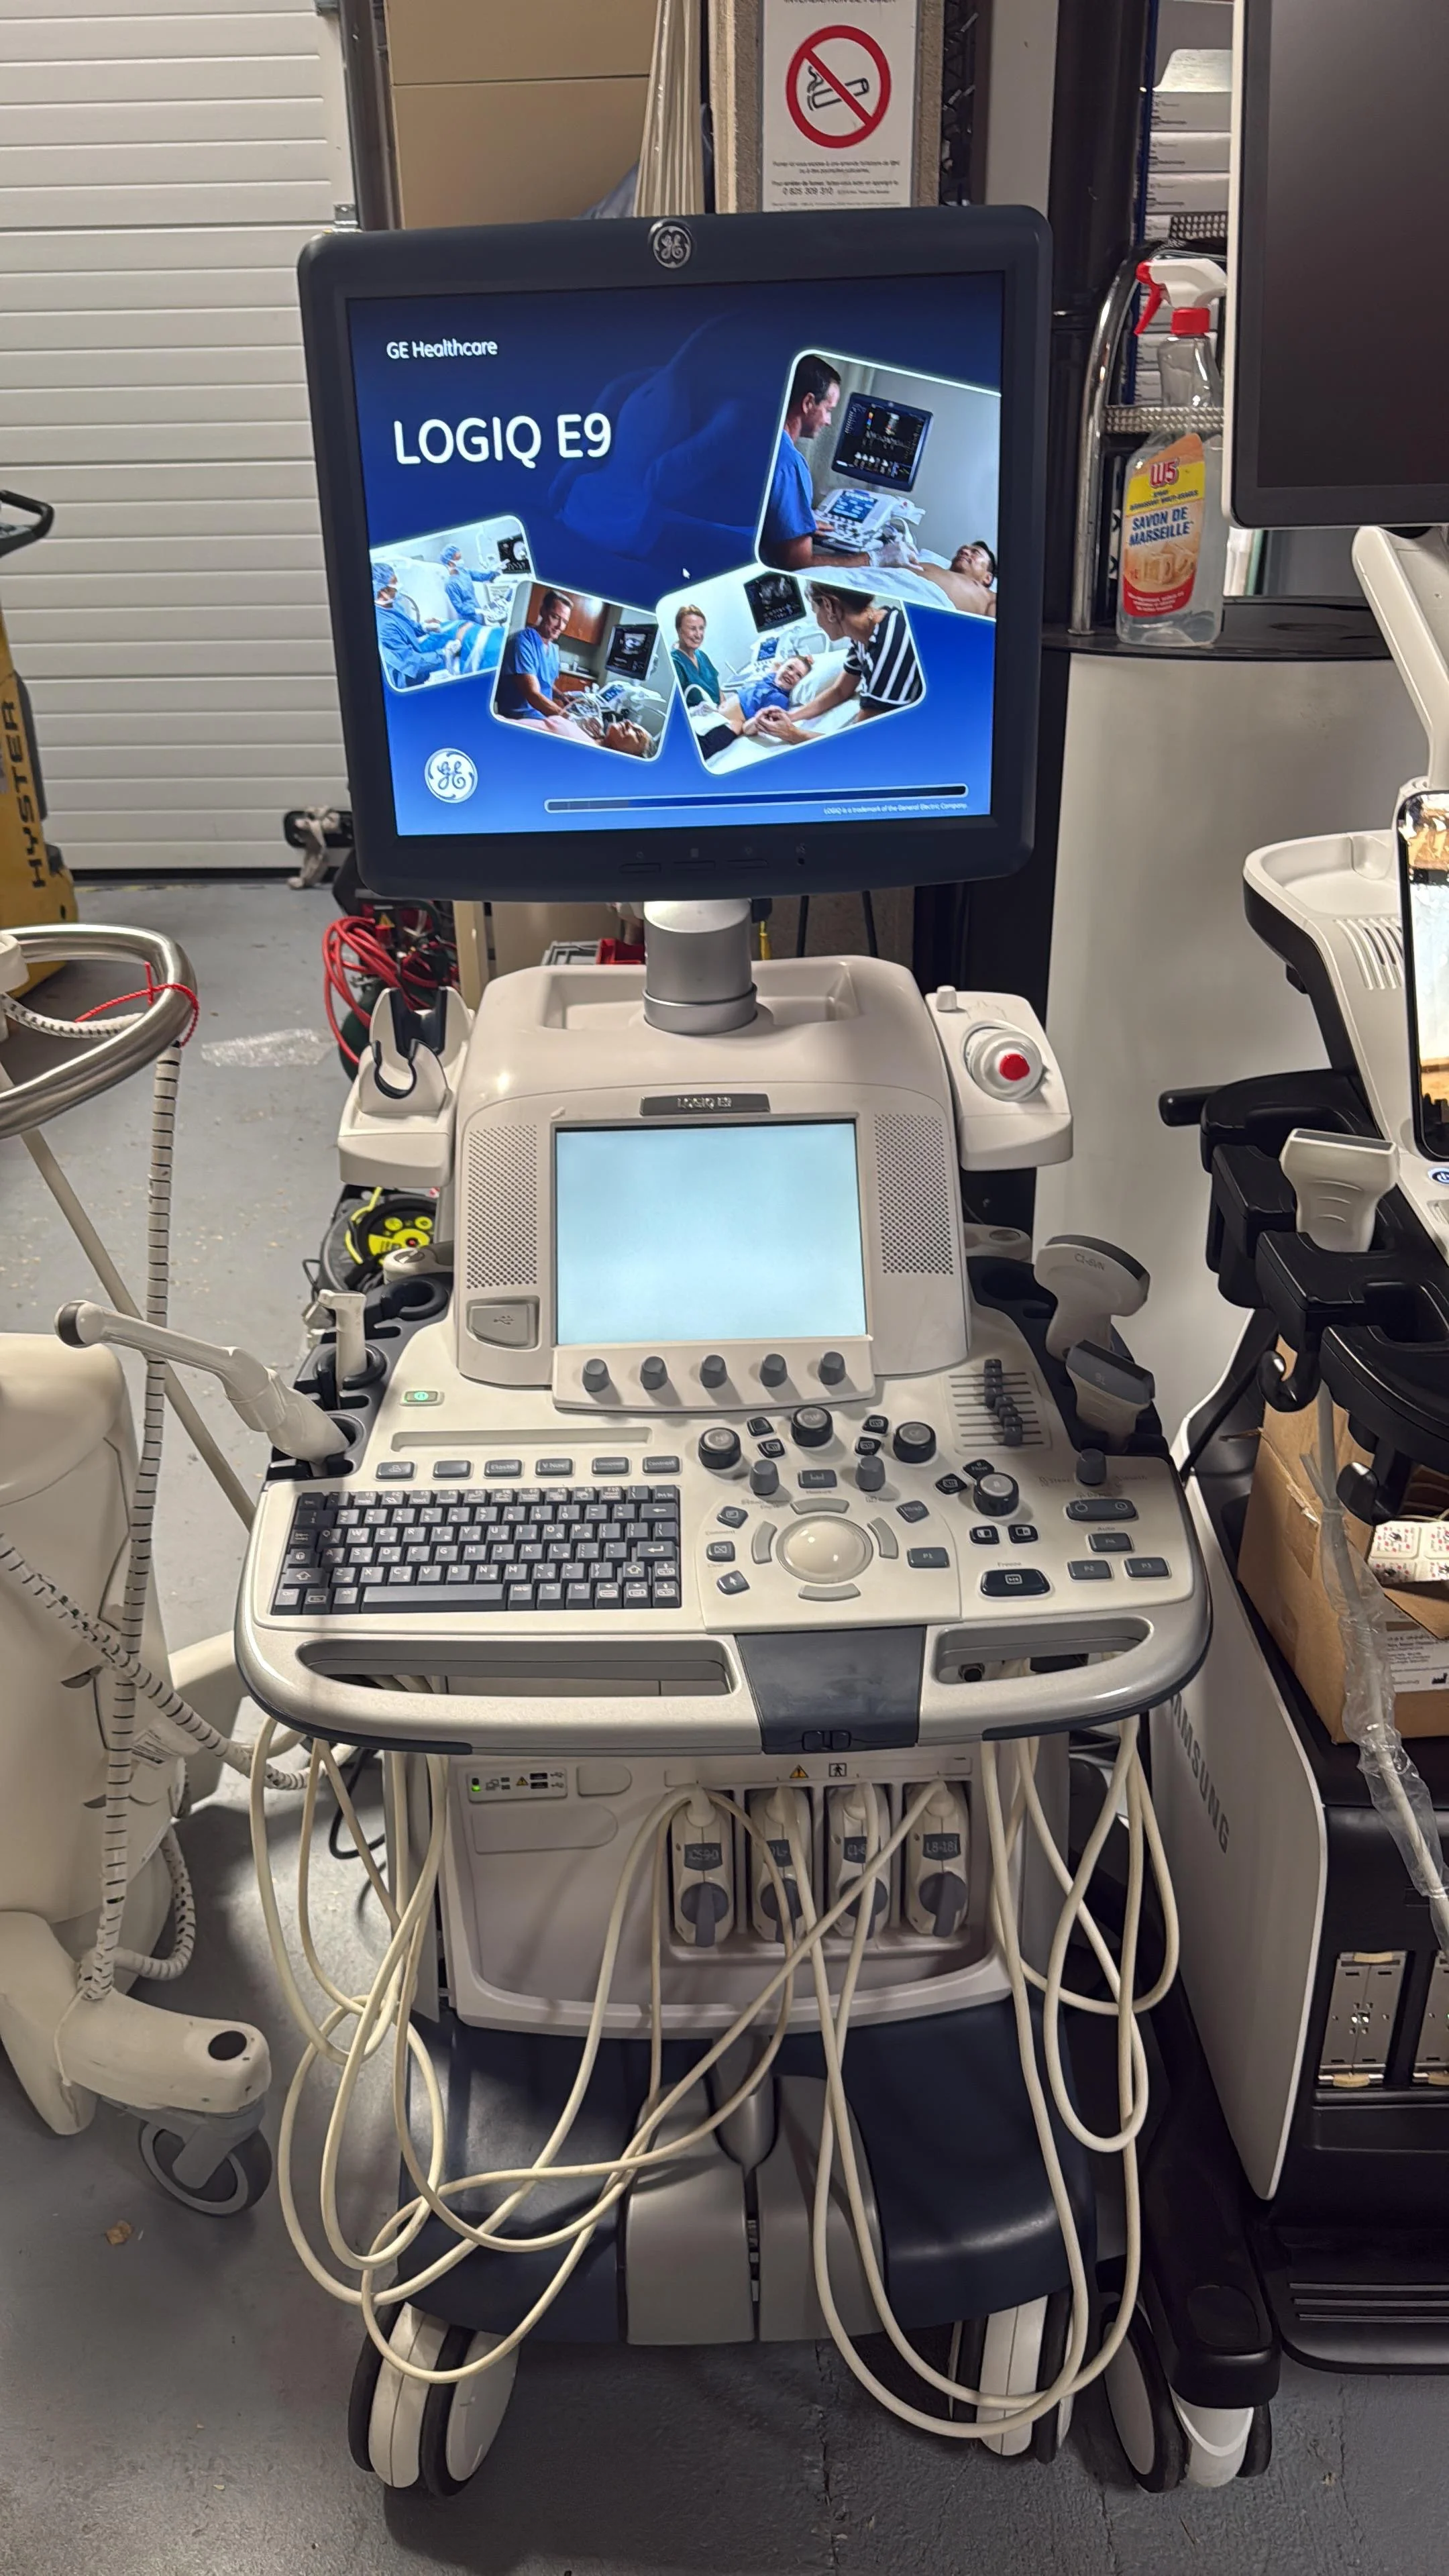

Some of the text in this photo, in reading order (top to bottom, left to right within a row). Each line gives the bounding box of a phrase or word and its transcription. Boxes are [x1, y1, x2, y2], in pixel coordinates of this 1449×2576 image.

[386, 338, 498, 359] GE Healthcare
[393, 412, 611, 469] LOGIQ E9
[1129, 521, 1191, 547] MARSEILLE
[1132, 506, 1189, 531] SAVON DE
[1, 701, 46, 888] HYSTER
[1171, 1692, 1229, 1854] AMSUNG
